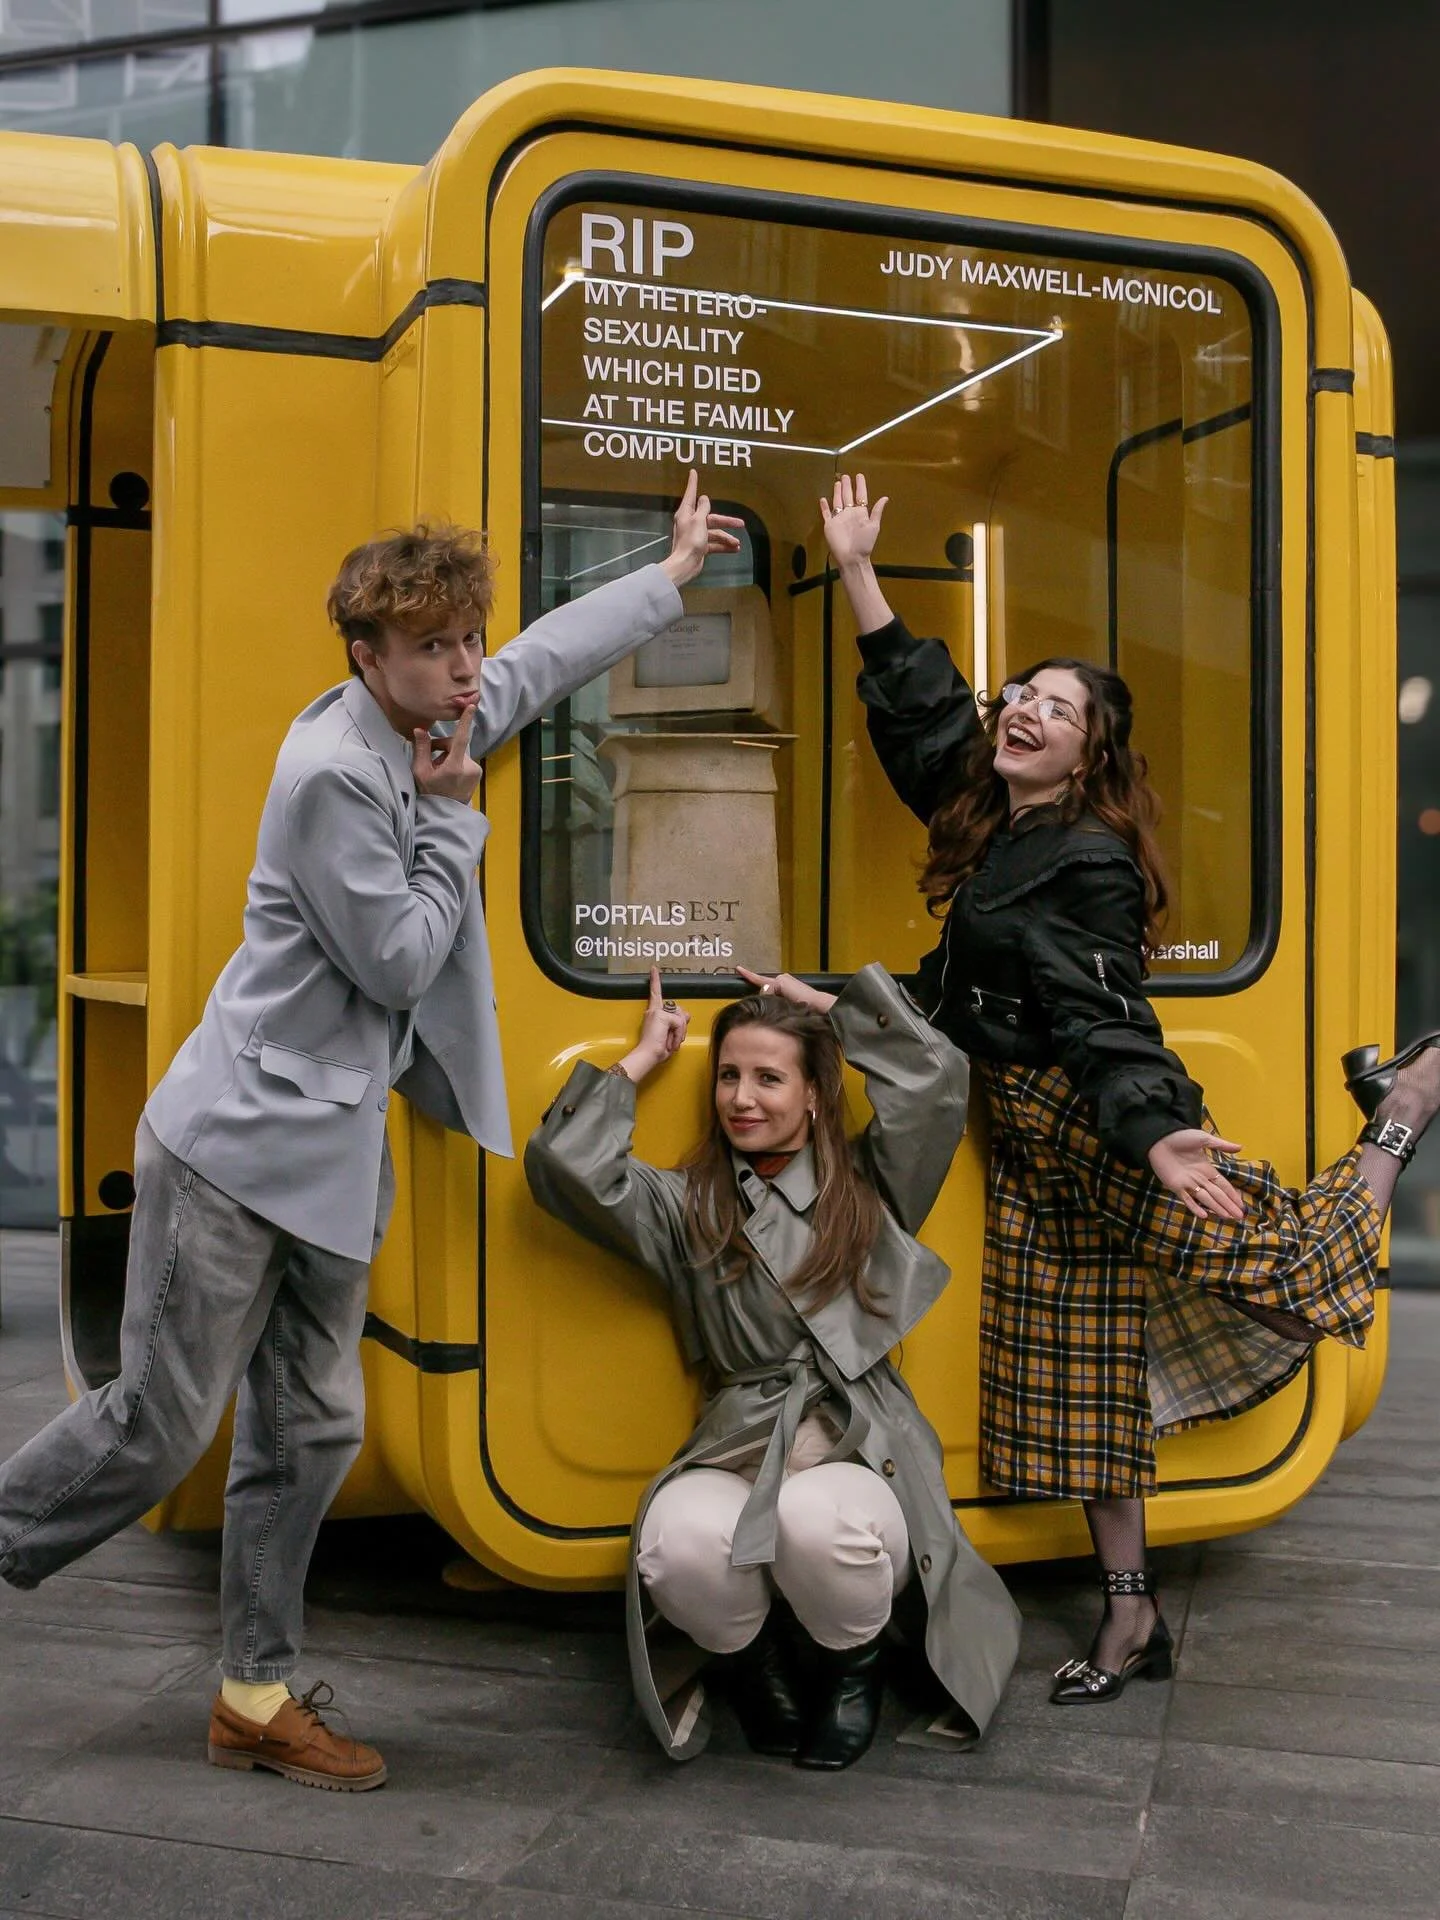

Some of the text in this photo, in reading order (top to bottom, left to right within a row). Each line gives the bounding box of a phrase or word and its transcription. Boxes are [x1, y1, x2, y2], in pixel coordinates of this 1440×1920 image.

[581, 212, 694, 277] RIP
[584, 281, 768, 319] MY HETERO-
[880, 249, 1222, 314] JUDY MAXWELL-MCNICOL
[583, 316, 744, 355] SEXUALITY
[583, 354, 761, 394] WHICH DIED
[583, 393, 794, 434] AT THE FAMILY
[583, 430, 752, 468] COMPUTER
[575, 904, 686, 926] PORTALS
[574, 936, 733, 961] @thisisportals
